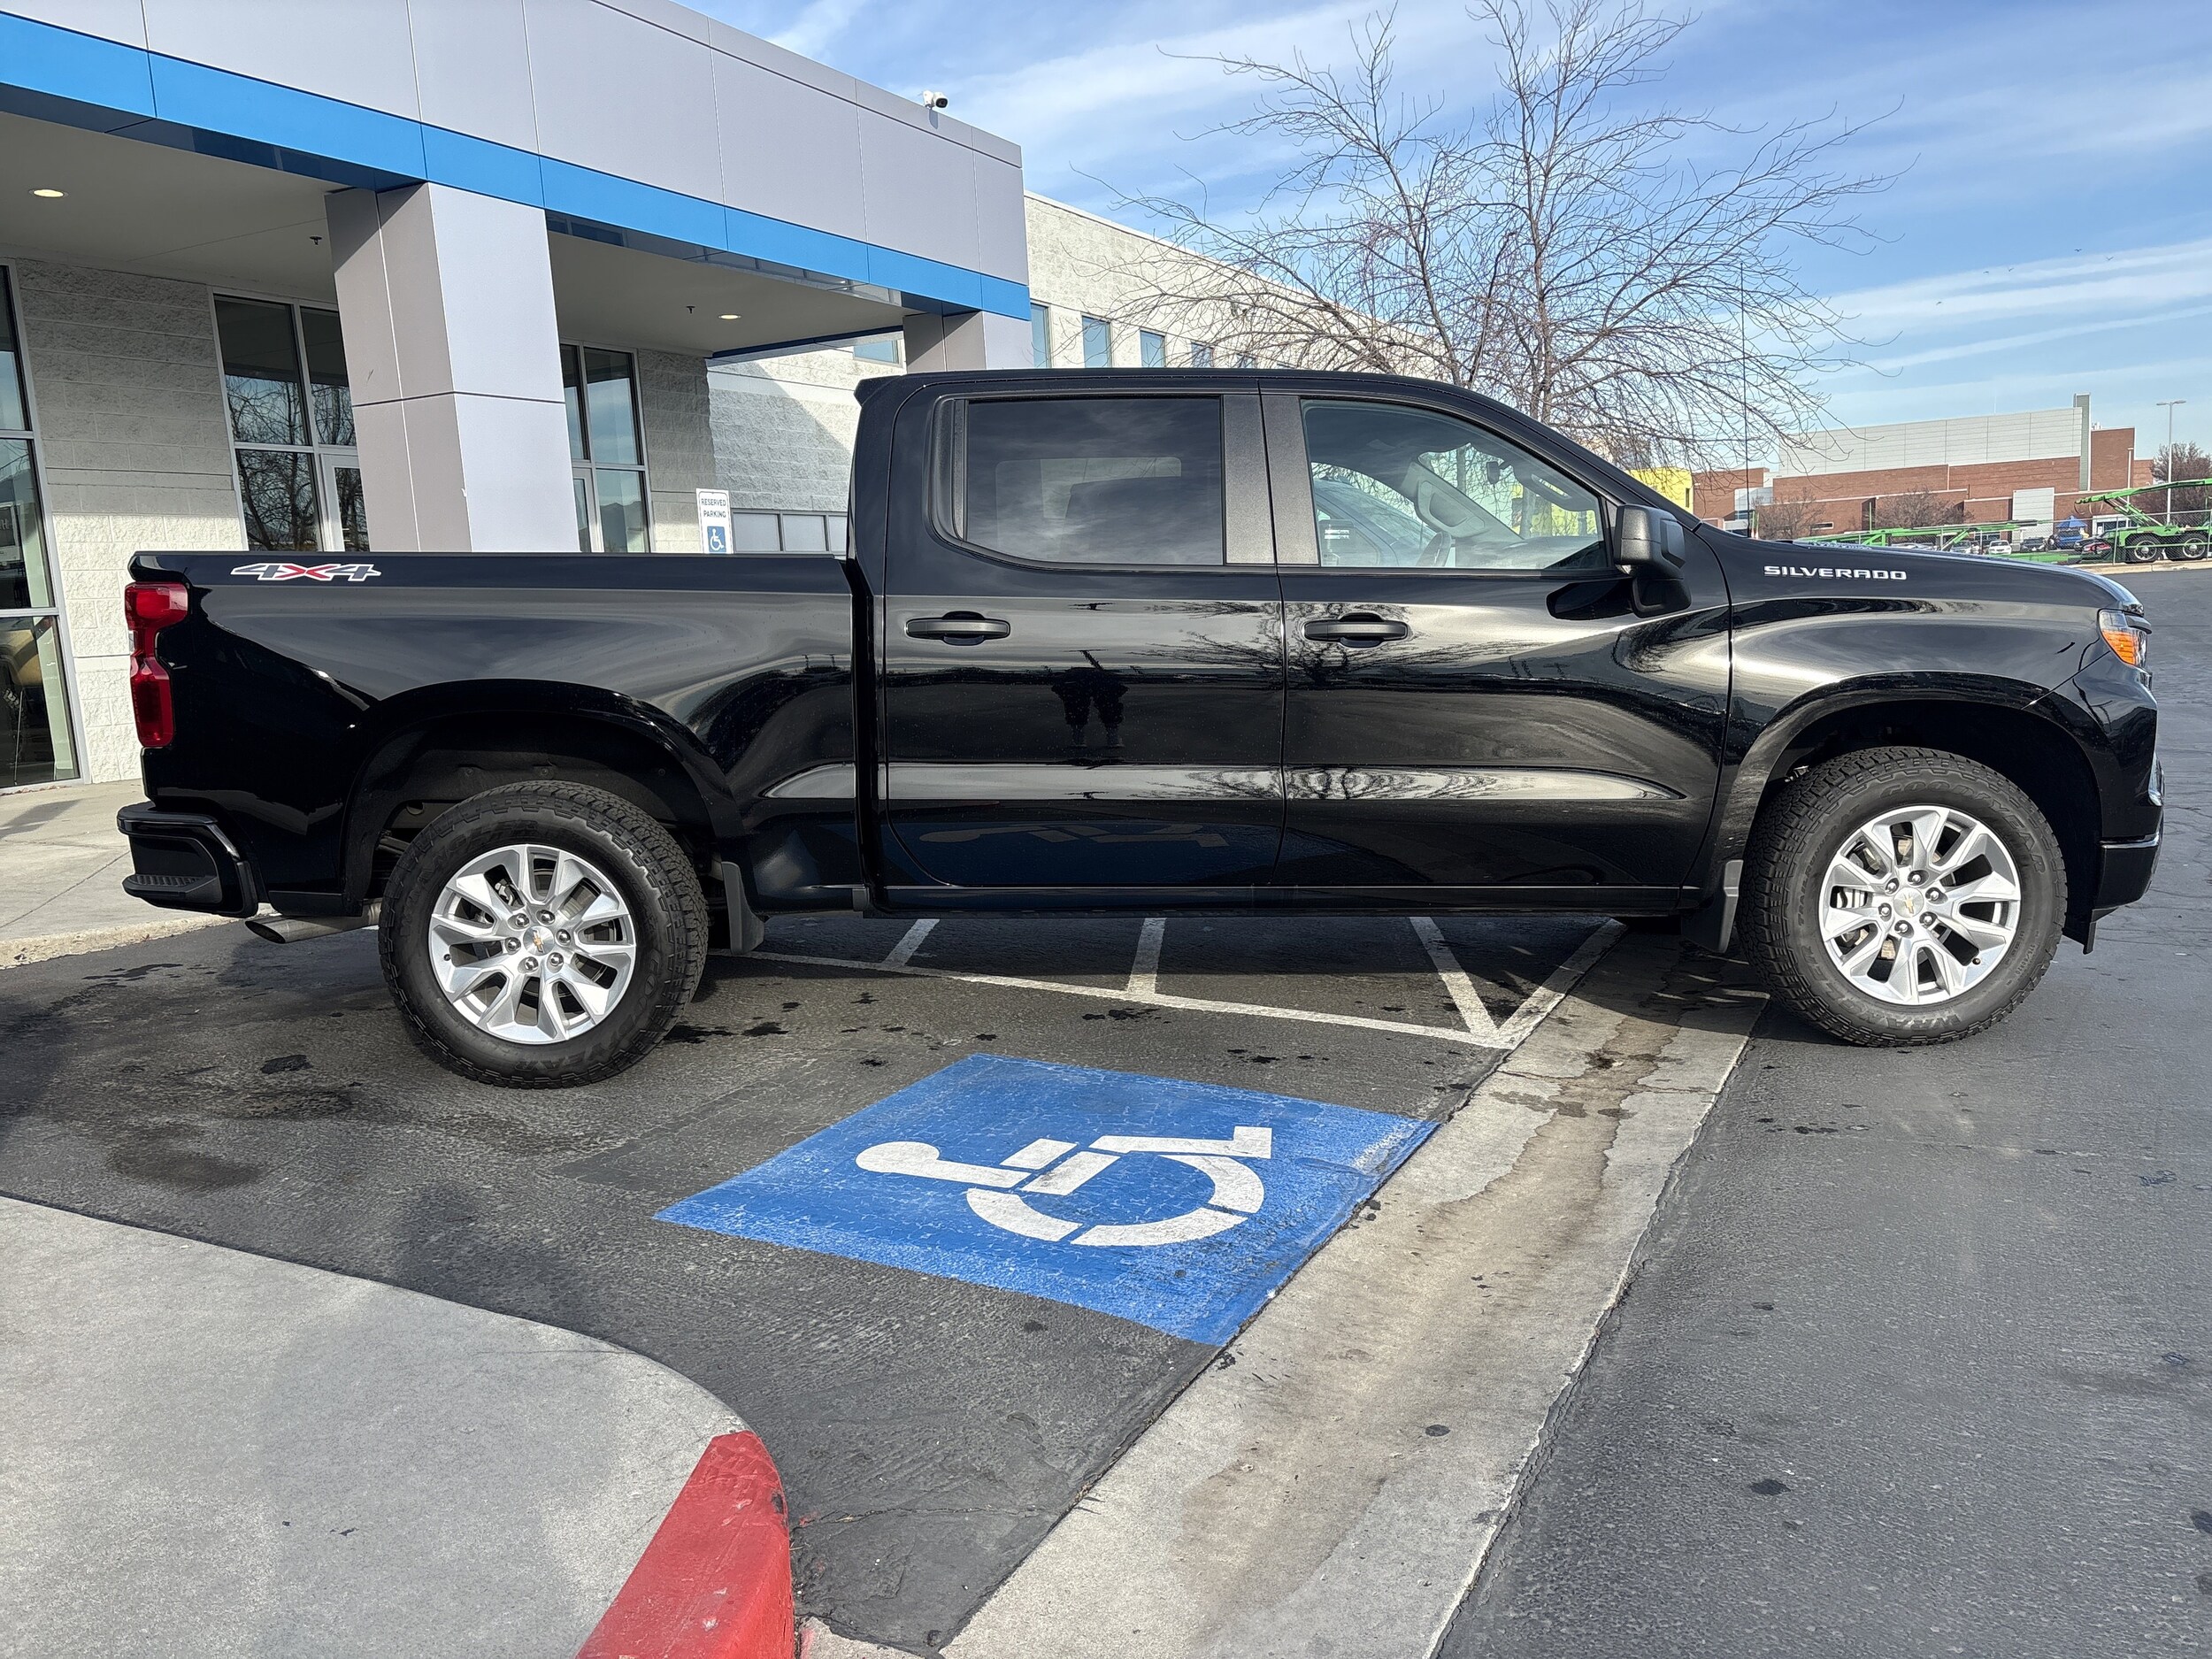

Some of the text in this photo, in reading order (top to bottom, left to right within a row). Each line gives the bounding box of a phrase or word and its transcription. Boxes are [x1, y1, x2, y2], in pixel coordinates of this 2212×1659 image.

[1763, 565, 1908, 580] SILVERADO
[1879, 780, 2046, 873] GOODYEAR
[1801, 946, 1962, 1032] WRANGLER
